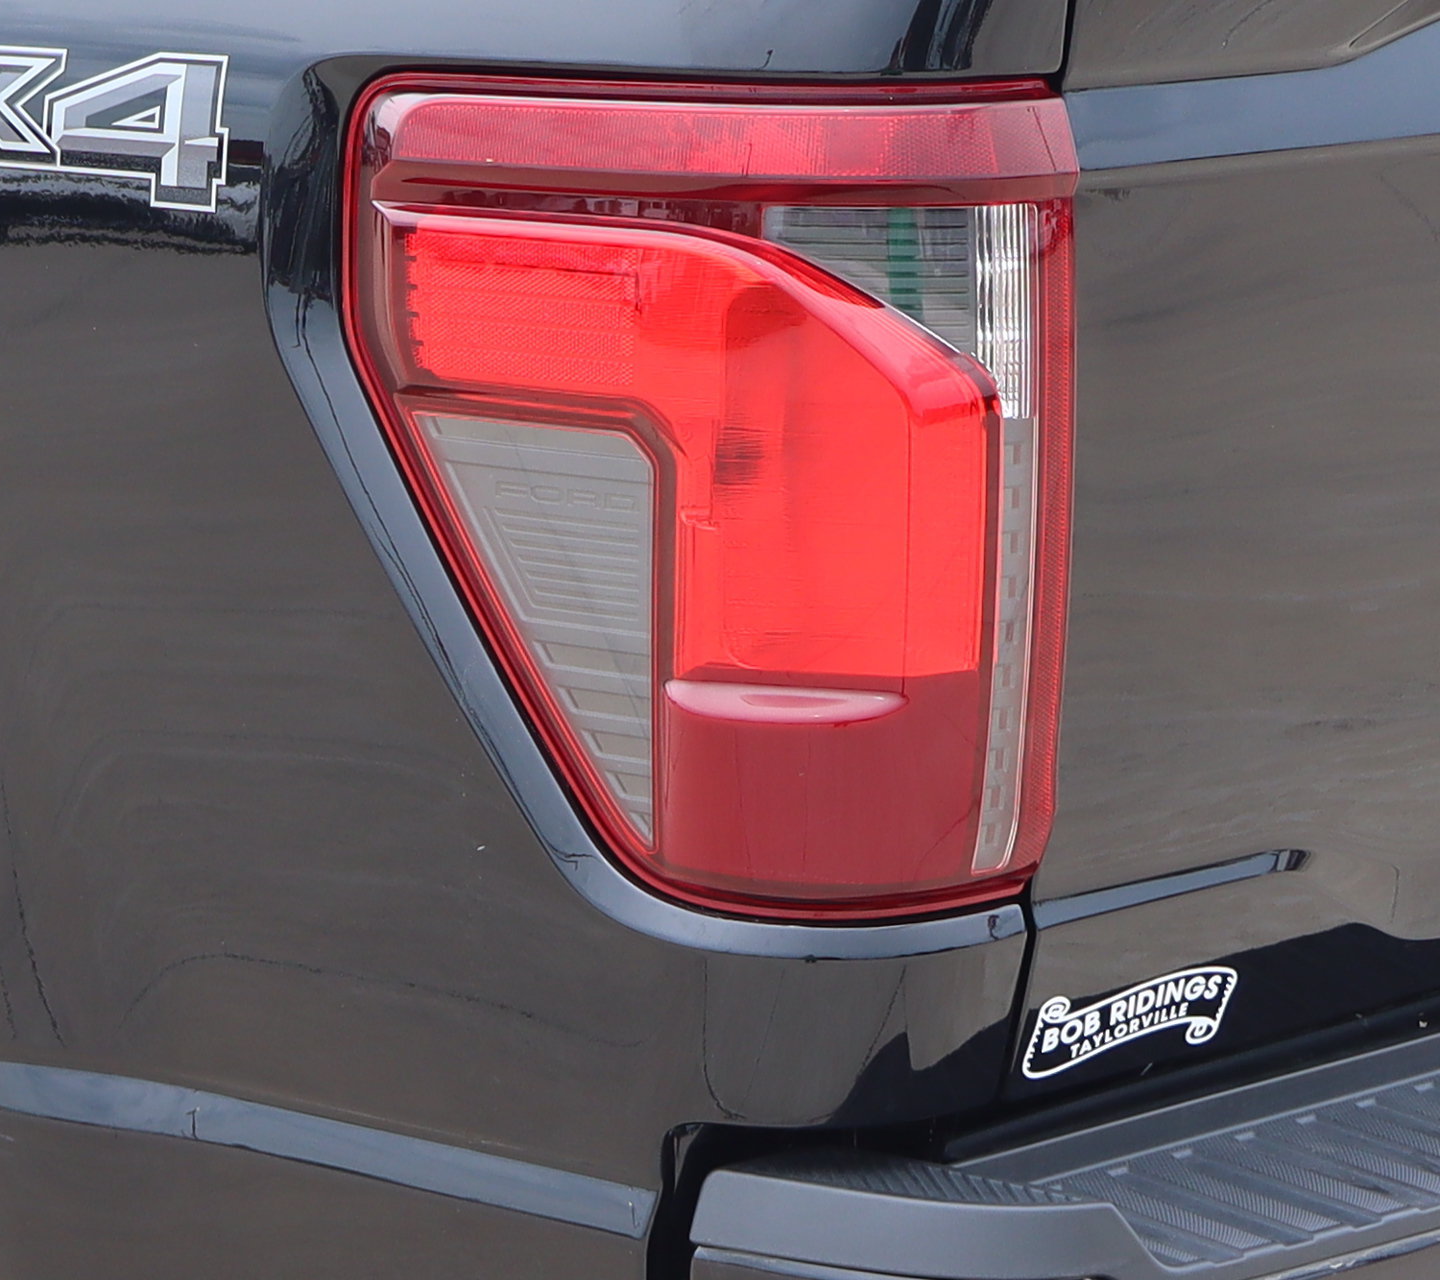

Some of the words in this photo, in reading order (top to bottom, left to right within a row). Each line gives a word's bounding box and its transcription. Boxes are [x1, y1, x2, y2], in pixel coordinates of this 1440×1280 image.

[494, 480, 641, 514] FORD
[1041, 1010, 1101, 1054] BOB
[1109, 974, 1222, 1026] RIDINGS
[1070, 1002, 1189, 1058] TAYLORVILLE
